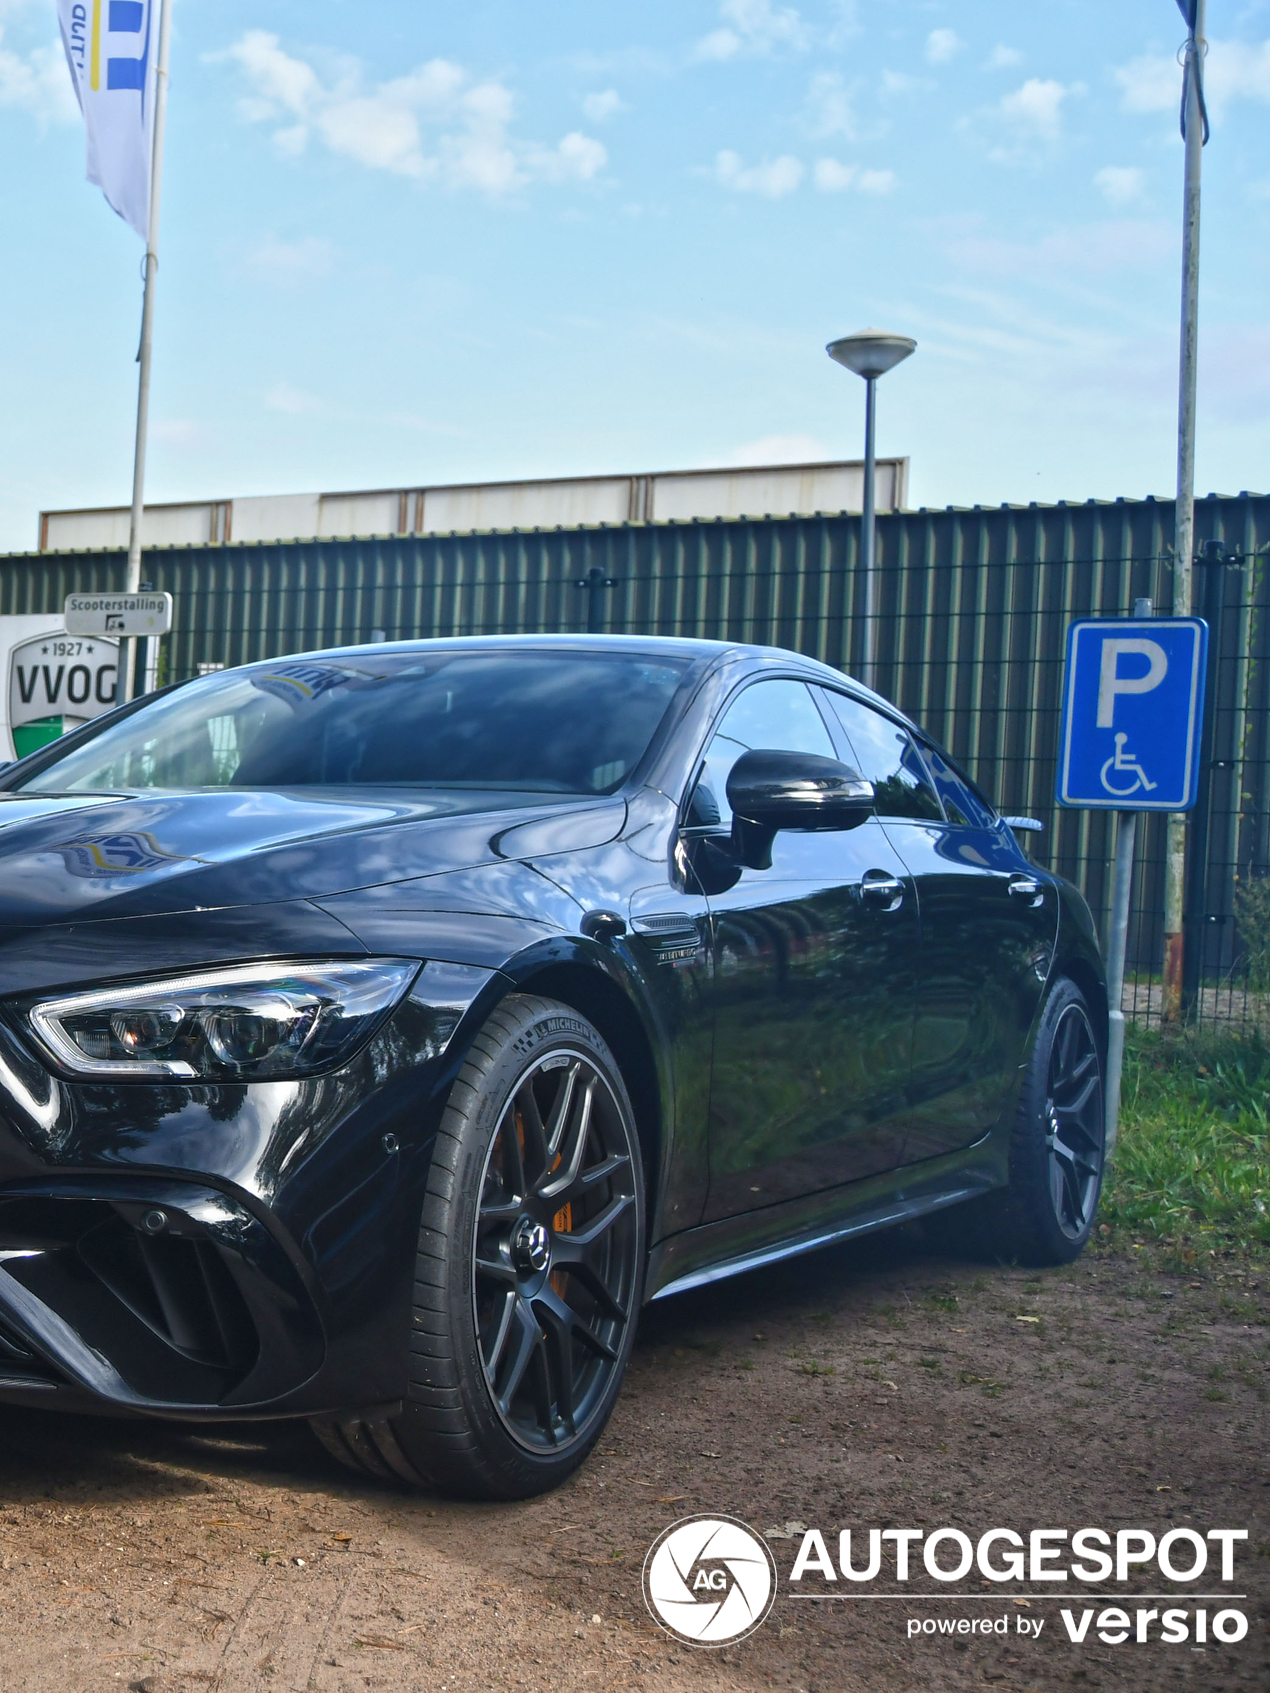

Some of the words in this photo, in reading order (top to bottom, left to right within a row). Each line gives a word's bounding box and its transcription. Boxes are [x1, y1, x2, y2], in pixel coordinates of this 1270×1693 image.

[70, 599, 165, 613] Scooterstalling
[52, 642, 83, 656] 1927
[16, 664, 117, 704] VVOG
[1096, 638, 1168, 728] P
[547, 1019, 589, 1037] MICHELIN
